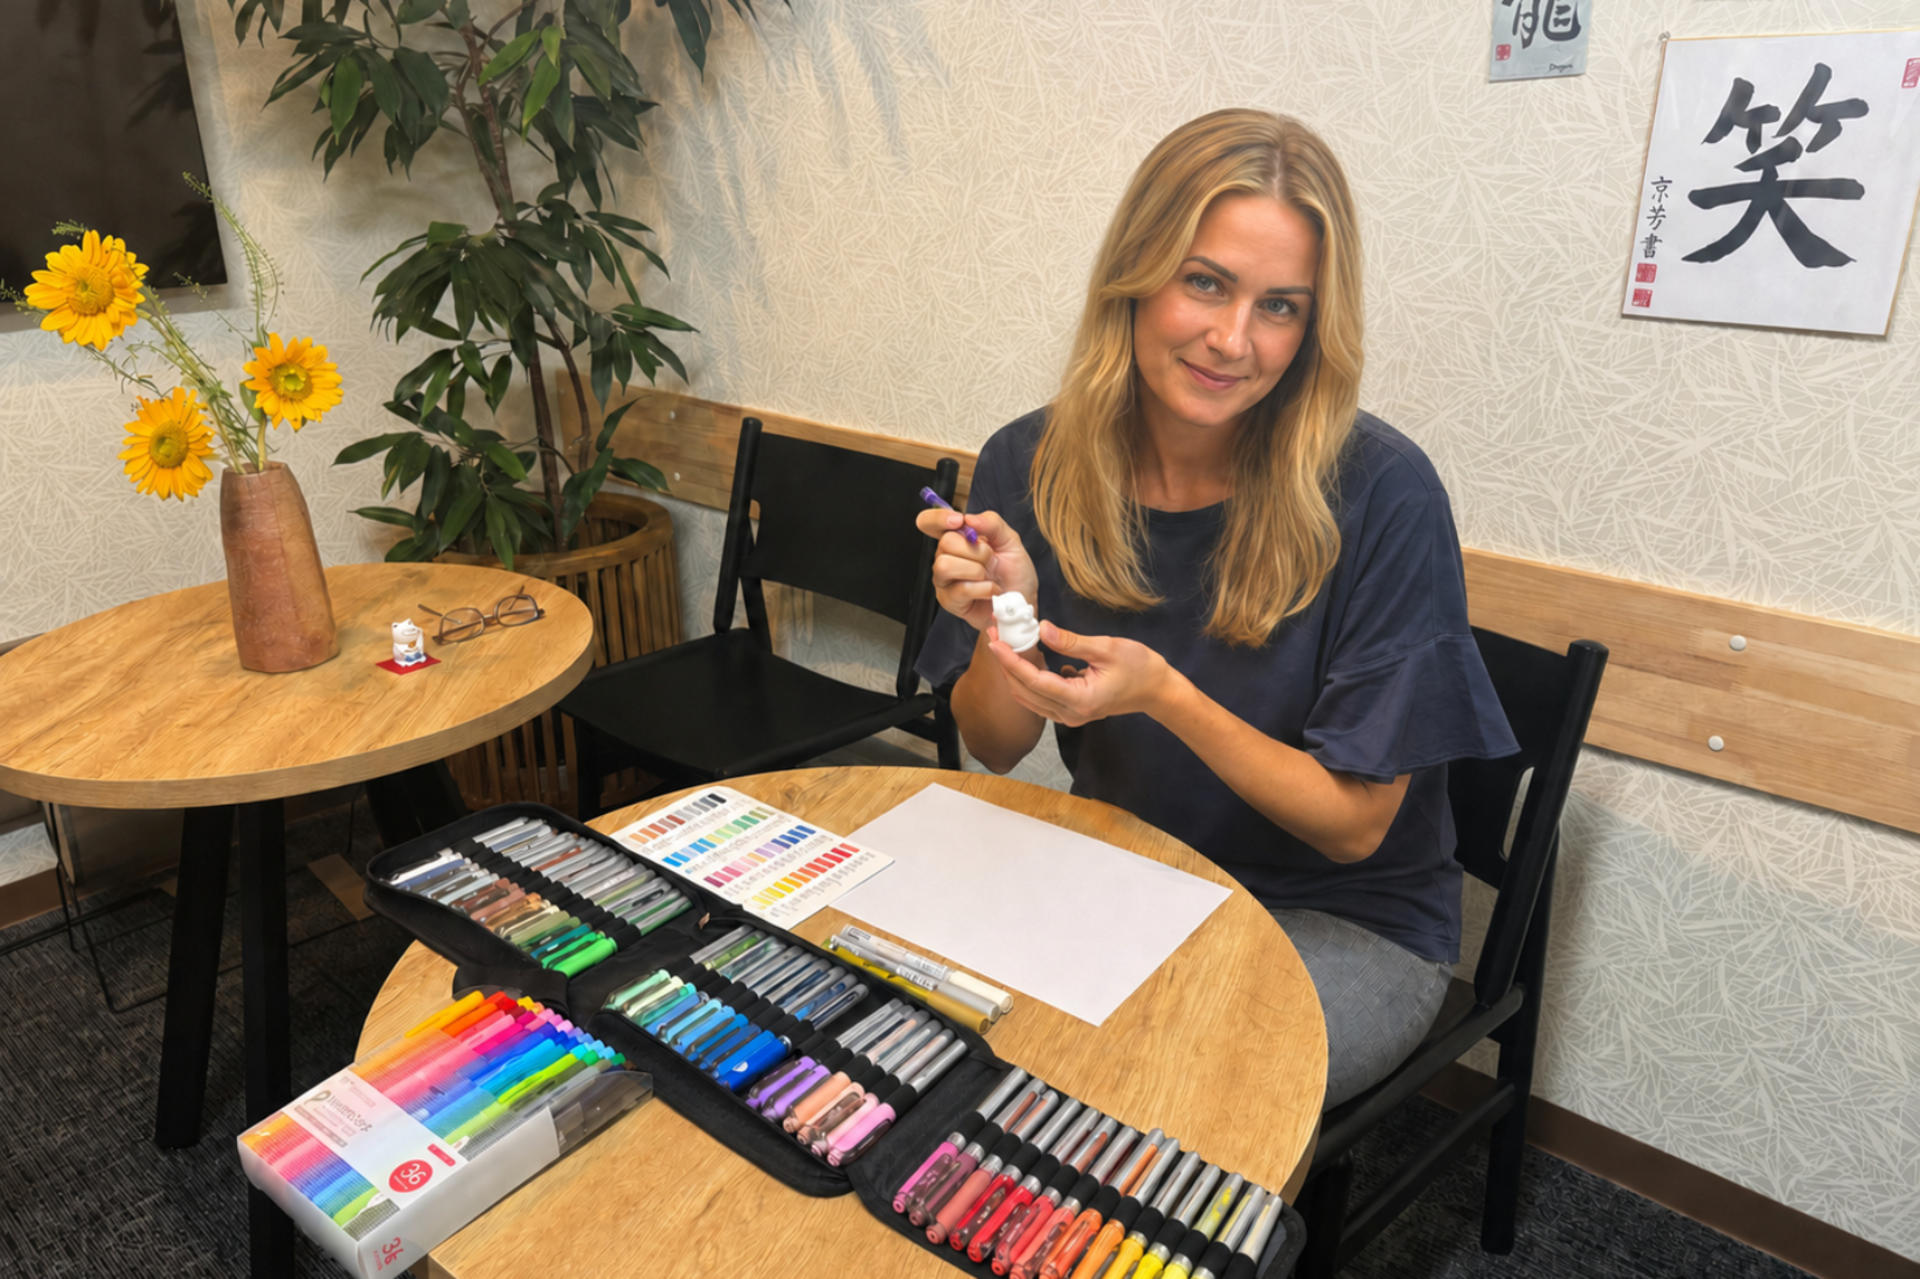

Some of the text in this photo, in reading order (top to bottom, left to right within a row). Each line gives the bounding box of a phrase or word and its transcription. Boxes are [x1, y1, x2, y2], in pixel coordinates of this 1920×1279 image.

[1681, 62, 1869, 269] 笑
[1640, 176, 1673, 258] 京芳書
[400, 1163, 427, 1185] 36
